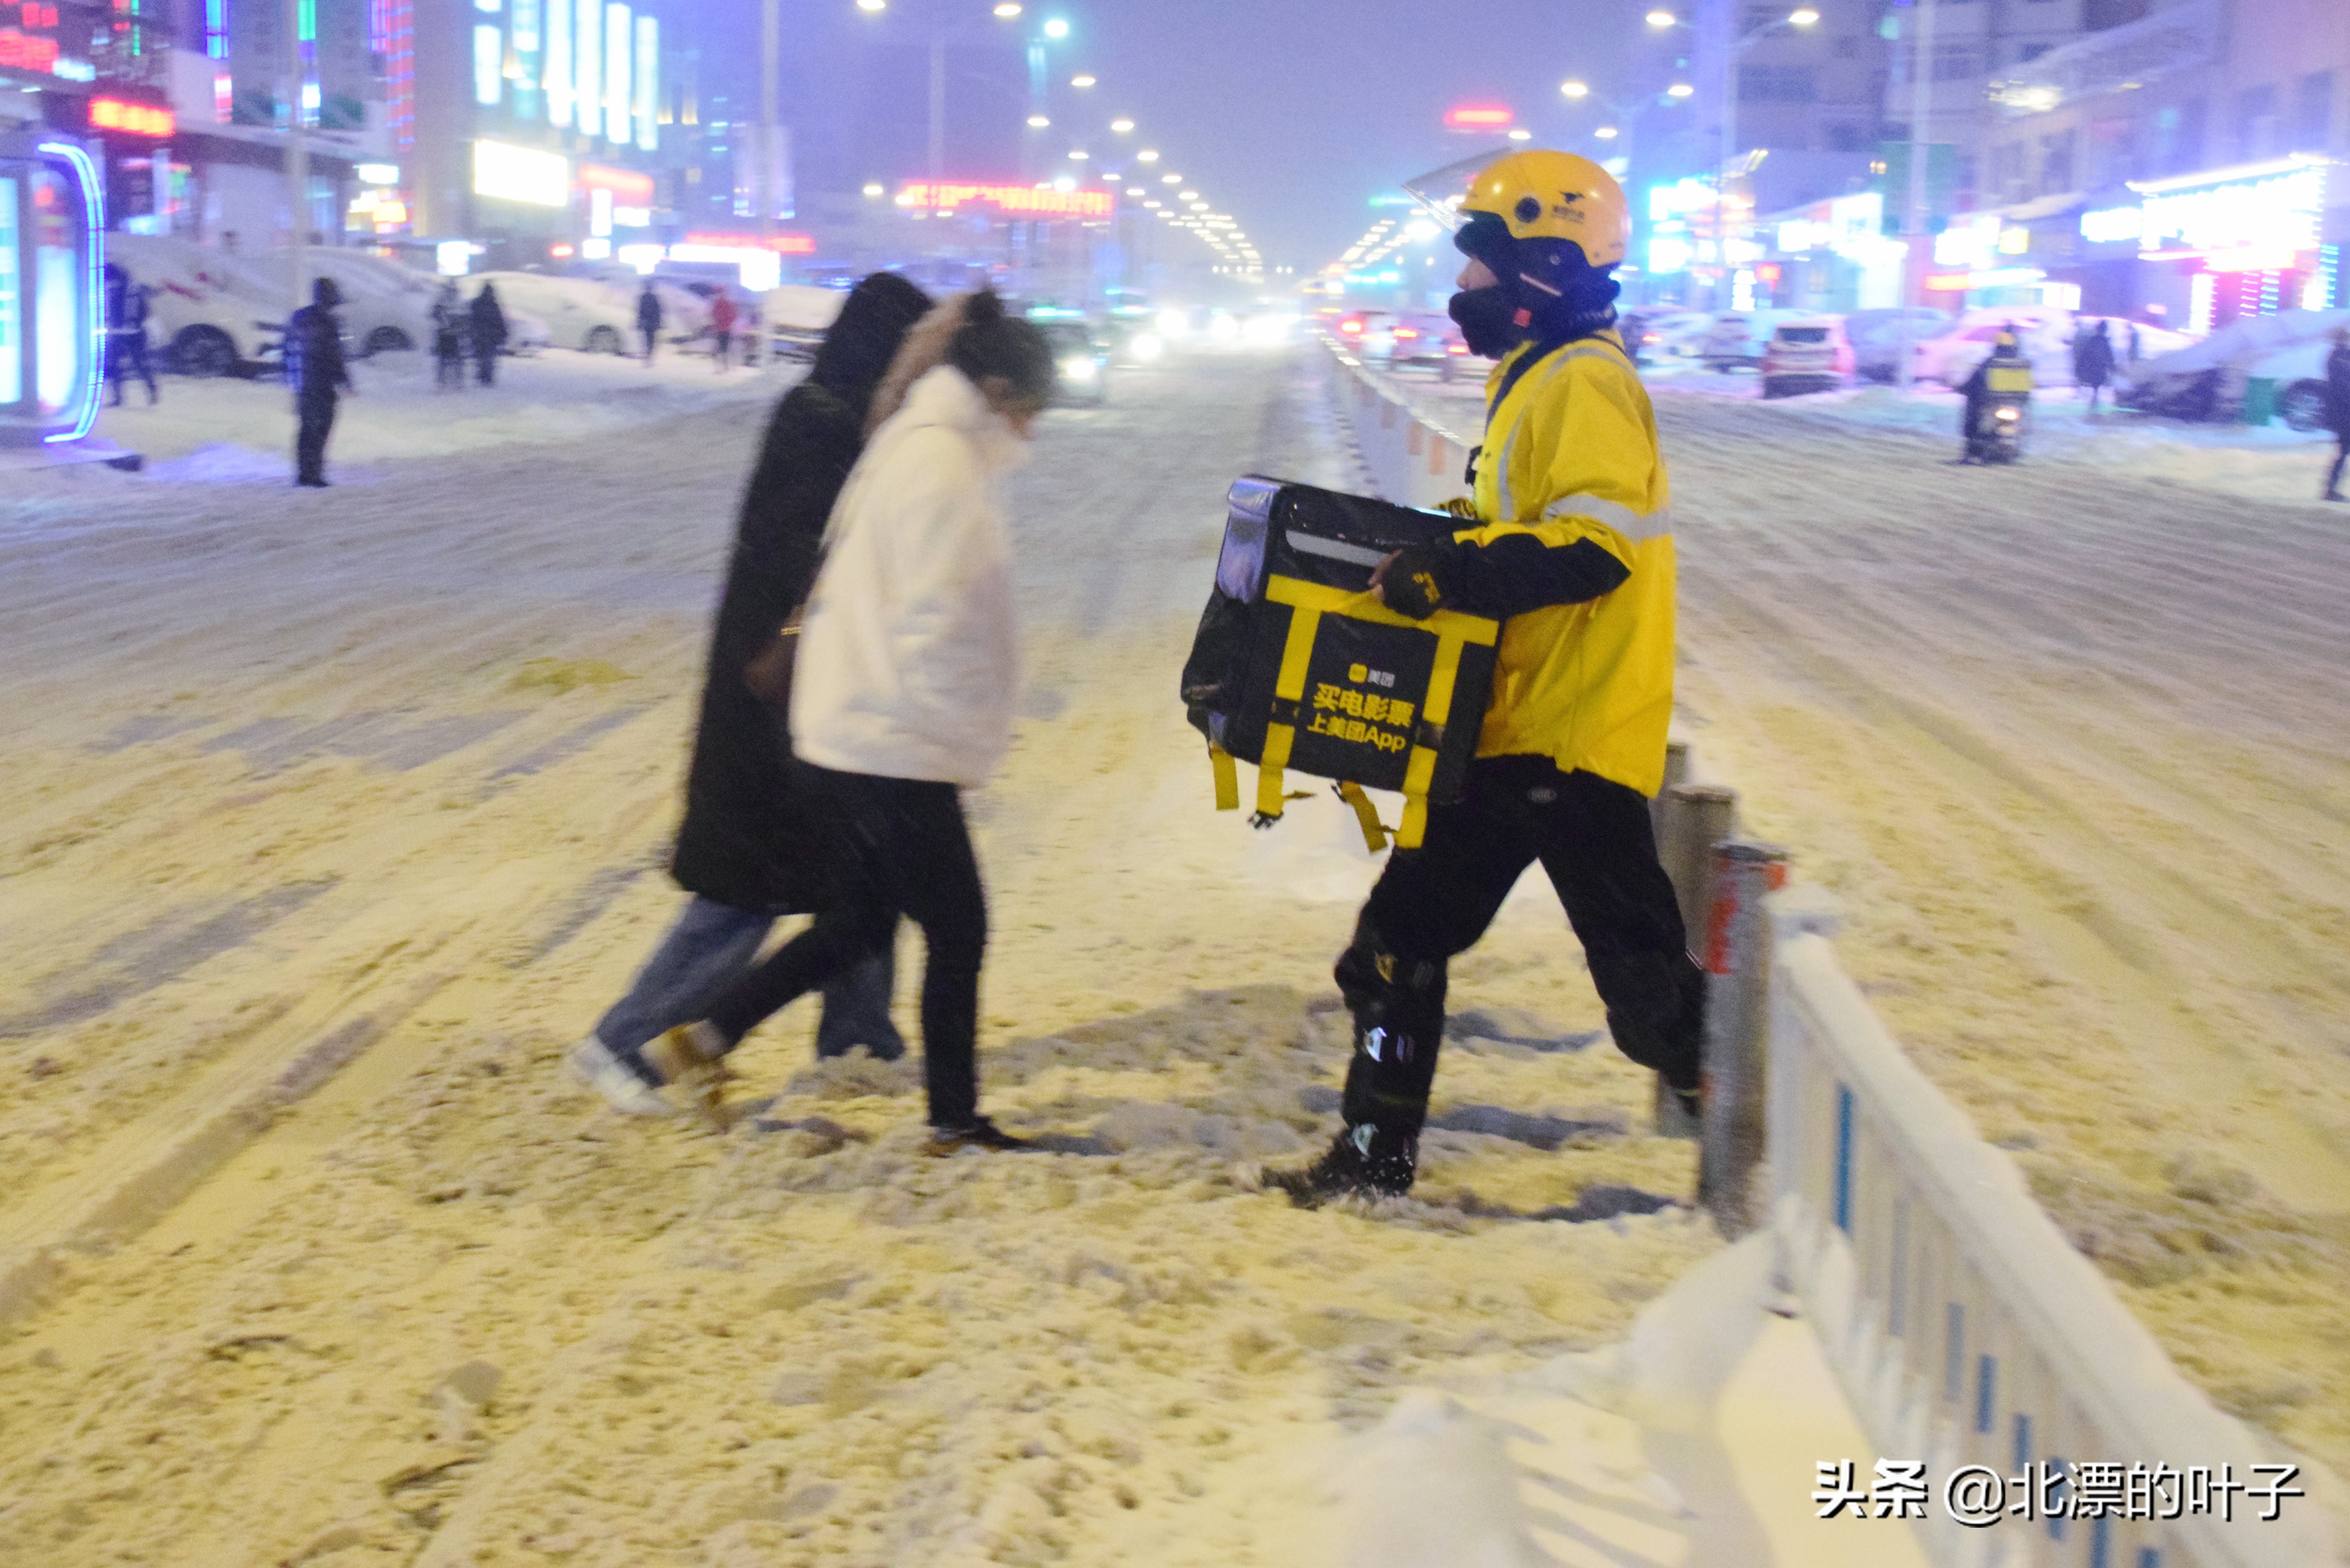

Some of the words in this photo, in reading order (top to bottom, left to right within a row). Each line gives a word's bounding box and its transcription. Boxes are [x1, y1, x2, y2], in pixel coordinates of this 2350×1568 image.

[1312, 682, 1415, 728] 买电影票
[1307, 712, 1407, 753] 上美团App
